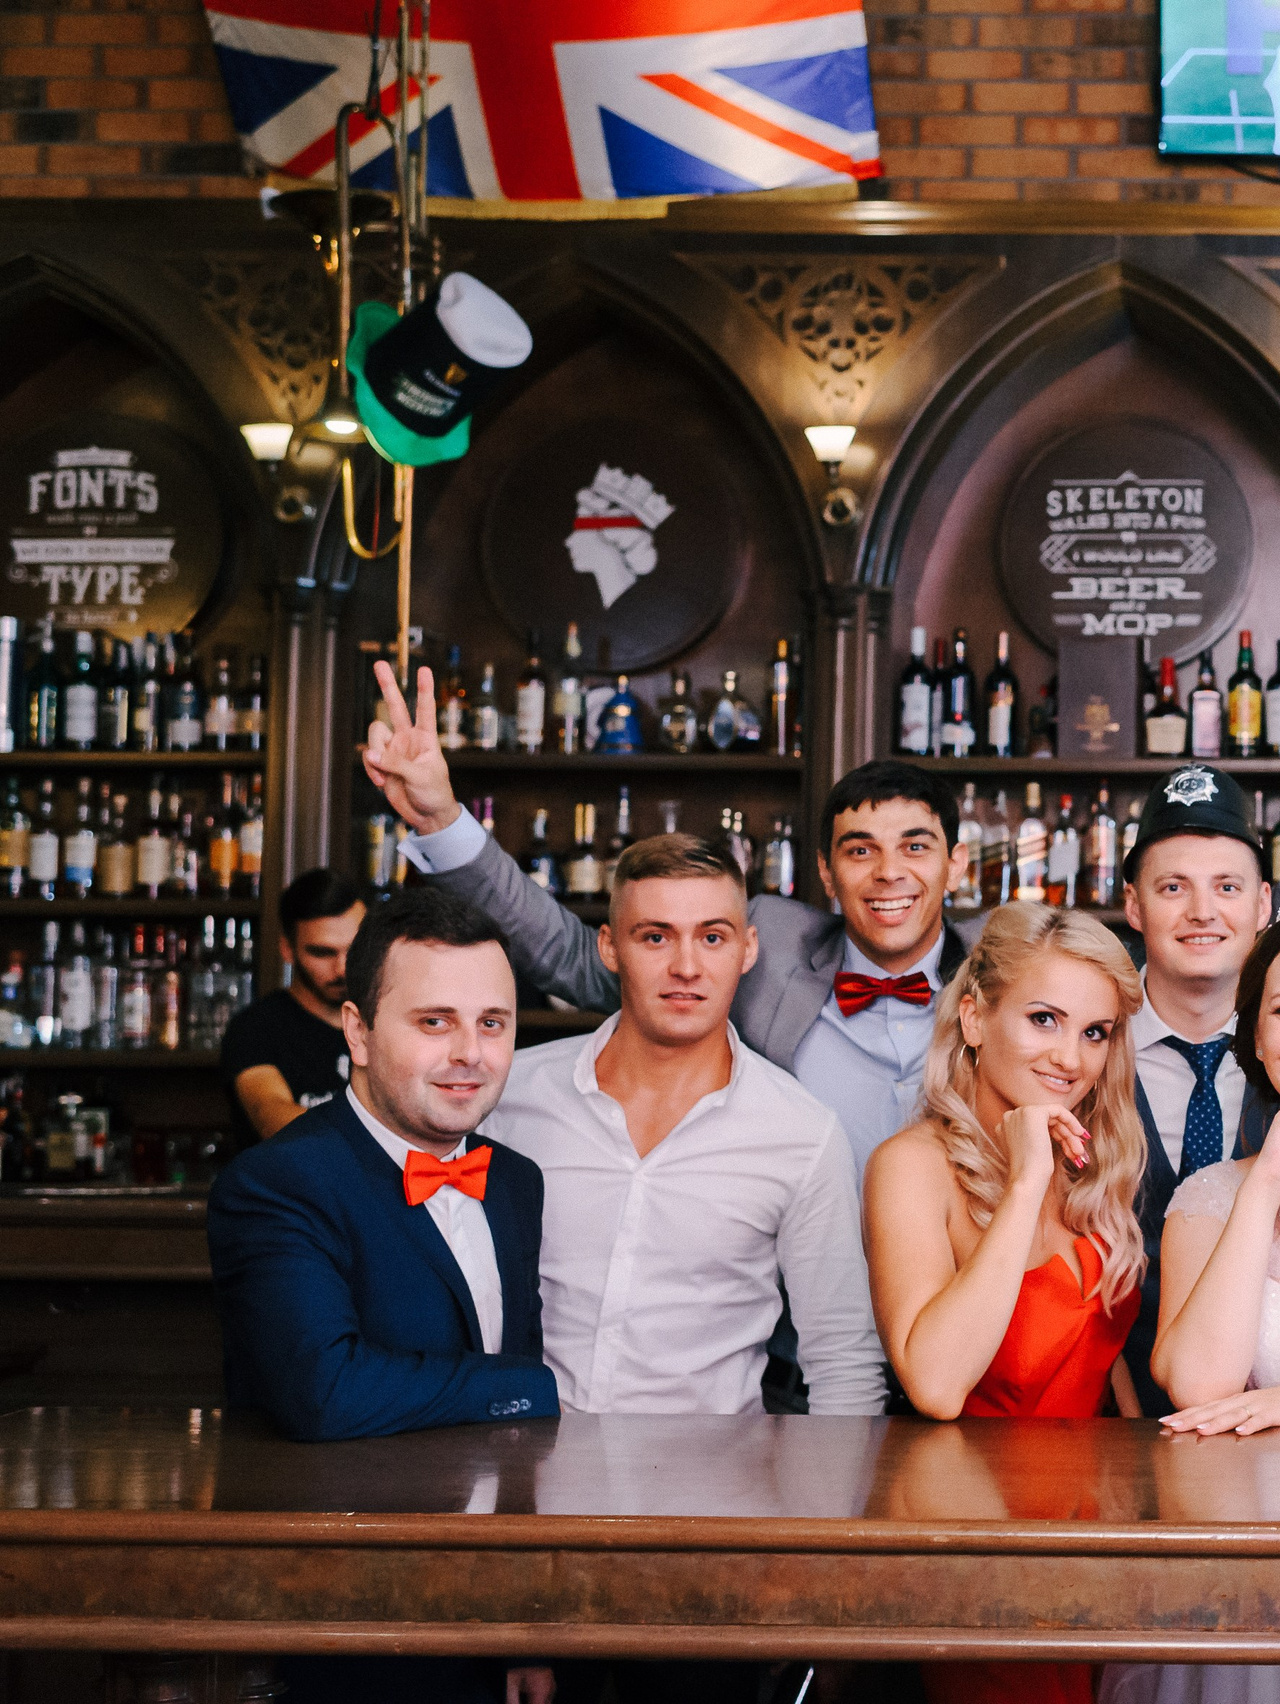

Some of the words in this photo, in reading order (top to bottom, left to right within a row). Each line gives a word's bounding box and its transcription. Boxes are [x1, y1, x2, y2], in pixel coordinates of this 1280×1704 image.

[29, 468, 159, 514] FONTS
[1046, 487, 1203, 517] SKELETON
[1154, 513, 1168, 529] A
[41, 565, 146, 605] TYPE
[1060, 577, 1194, 599] BEER
[1082, 613, 1174, 636] MOP
